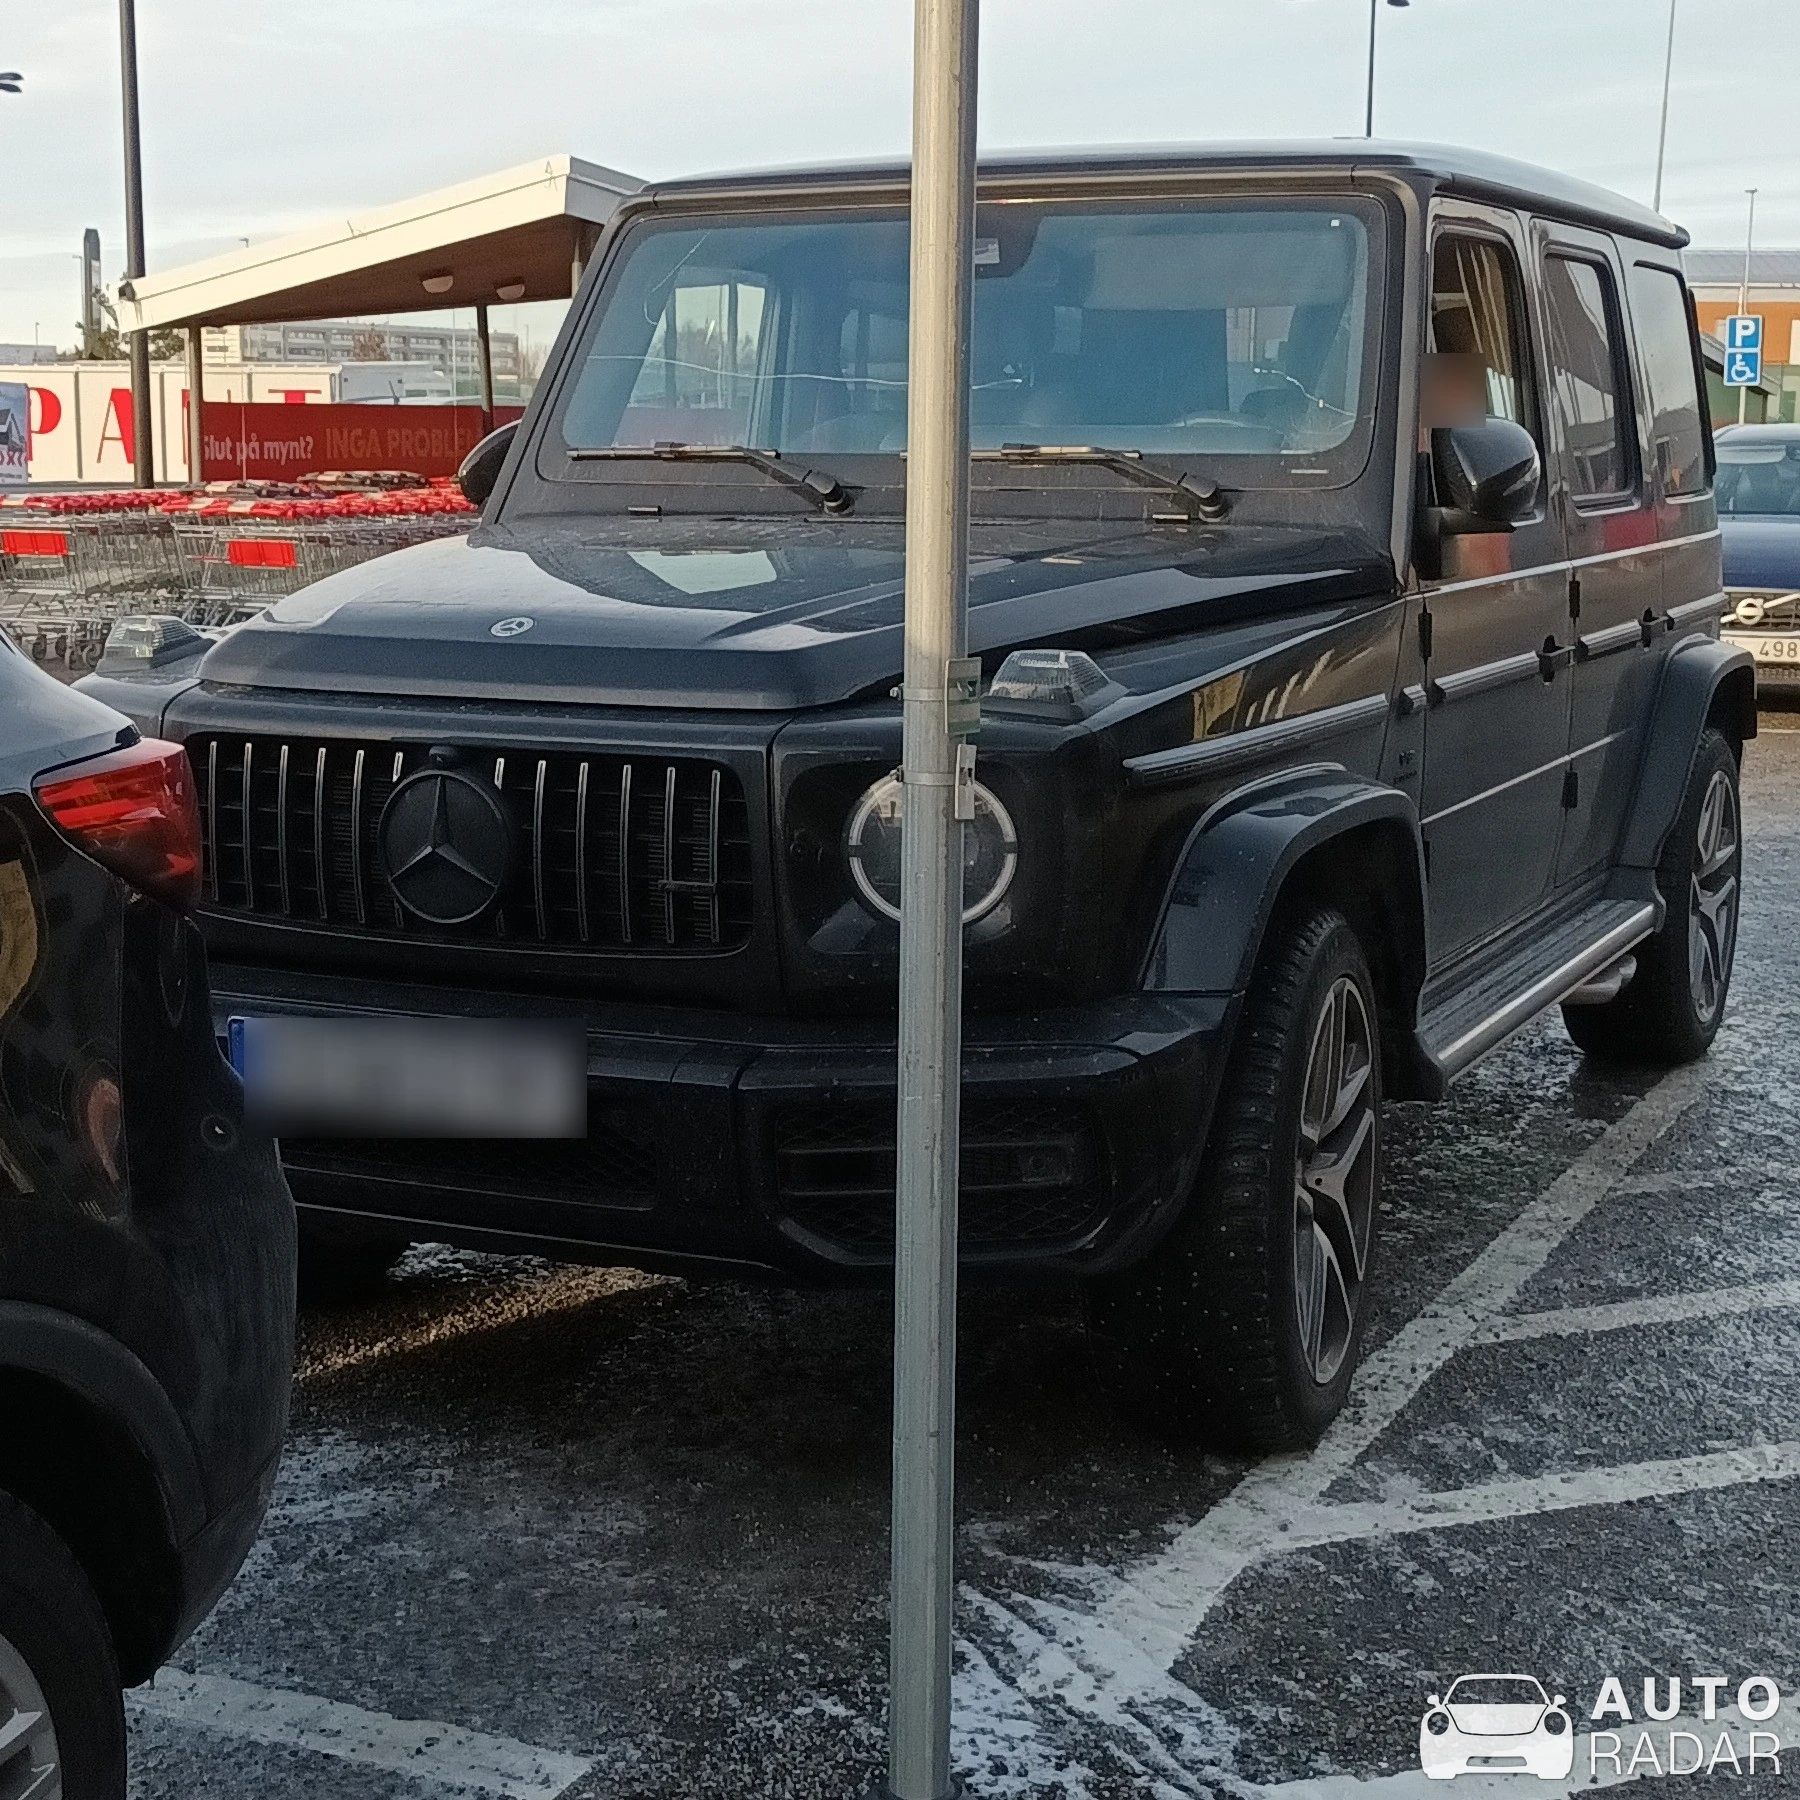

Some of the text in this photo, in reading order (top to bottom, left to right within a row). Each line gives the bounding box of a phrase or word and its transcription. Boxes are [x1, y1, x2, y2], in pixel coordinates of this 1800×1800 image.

[1735, 319, 1755, 347] P
[236, 432, 260, 466] på
[264, 435, 314, 466] mynt?
[326, 428, 382, 460] INGA
[387, 428, 472, 459] PROBLE
[1759, 641, 1798, 658] 498
